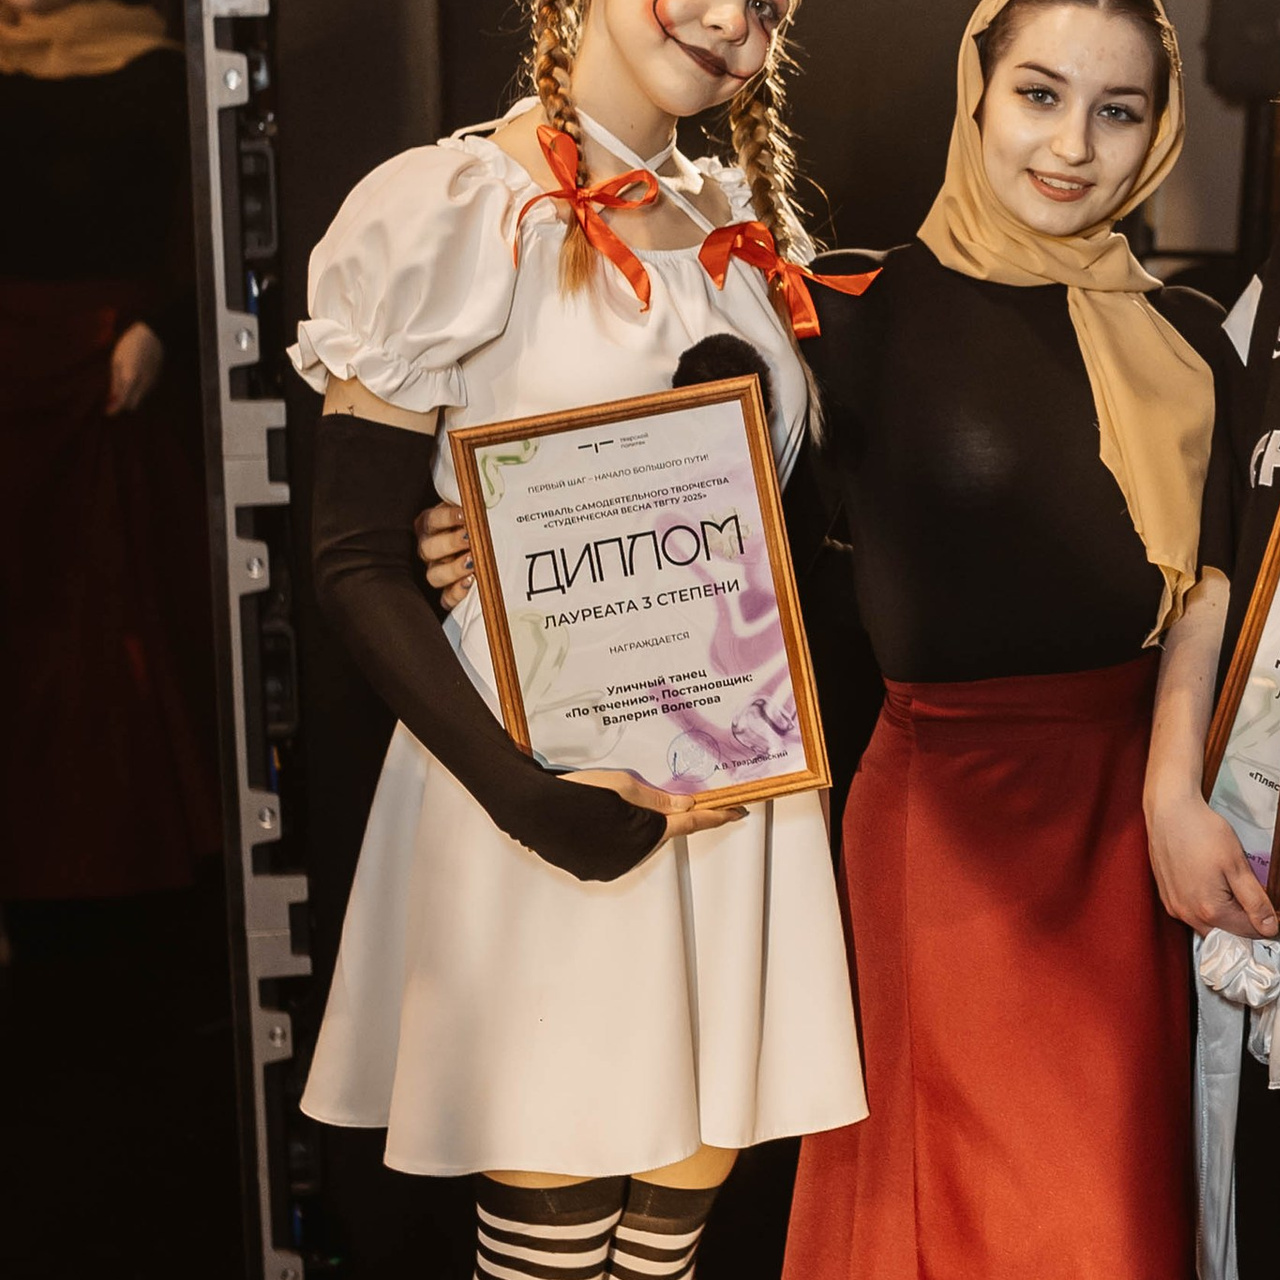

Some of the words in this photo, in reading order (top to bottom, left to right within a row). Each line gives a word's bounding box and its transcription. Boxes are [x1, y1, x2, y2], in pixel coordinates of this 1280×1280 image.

[527, 480, 566, 494] ПЕРВЫЙ
[567, 476, 587, 487] ШАГ
[594, 468, 631, 481] НАЧАЛО
[633, 458, 683, 475] БОЛЬШОГО
[684, 454, 710, 466] ПУТИ!
[516, 506, 574, 523] ФЕСТИВАЛЬ
[575, 488, 669, 512] САМОДЕЯТЕЛЬНОГО
[670, 477, 730, 495] ТВОРЧЕСТВА
[543, 508, 619, 528] «СТУДЕНЧЕСКАЯ
[621, 502, 653, 515] ВЕСНА
[654, 497, 681, 509] ТВГТУ
[525, 514, 745, 601] ДИПЛОМ
[544, 599, 639, 629] ЛАУРЕАТА
[643, 596, 652, 609] 3
[657, 579, 740, 606] СТЕПЕНИ
[609, 631, 690, 655] НАГРАЖДАЕТСЯ
[565, 707, 590, 719] «По
[592, 694, 660, 713] течению»,
[661, 673, 754, 700] Постановщик:
[606, 676, 666, 696] Уличный
[668, 669, 707, 683] танец
[602, 708, 658, 726] Валерия
[661, 694, 721, 714] Волегова
